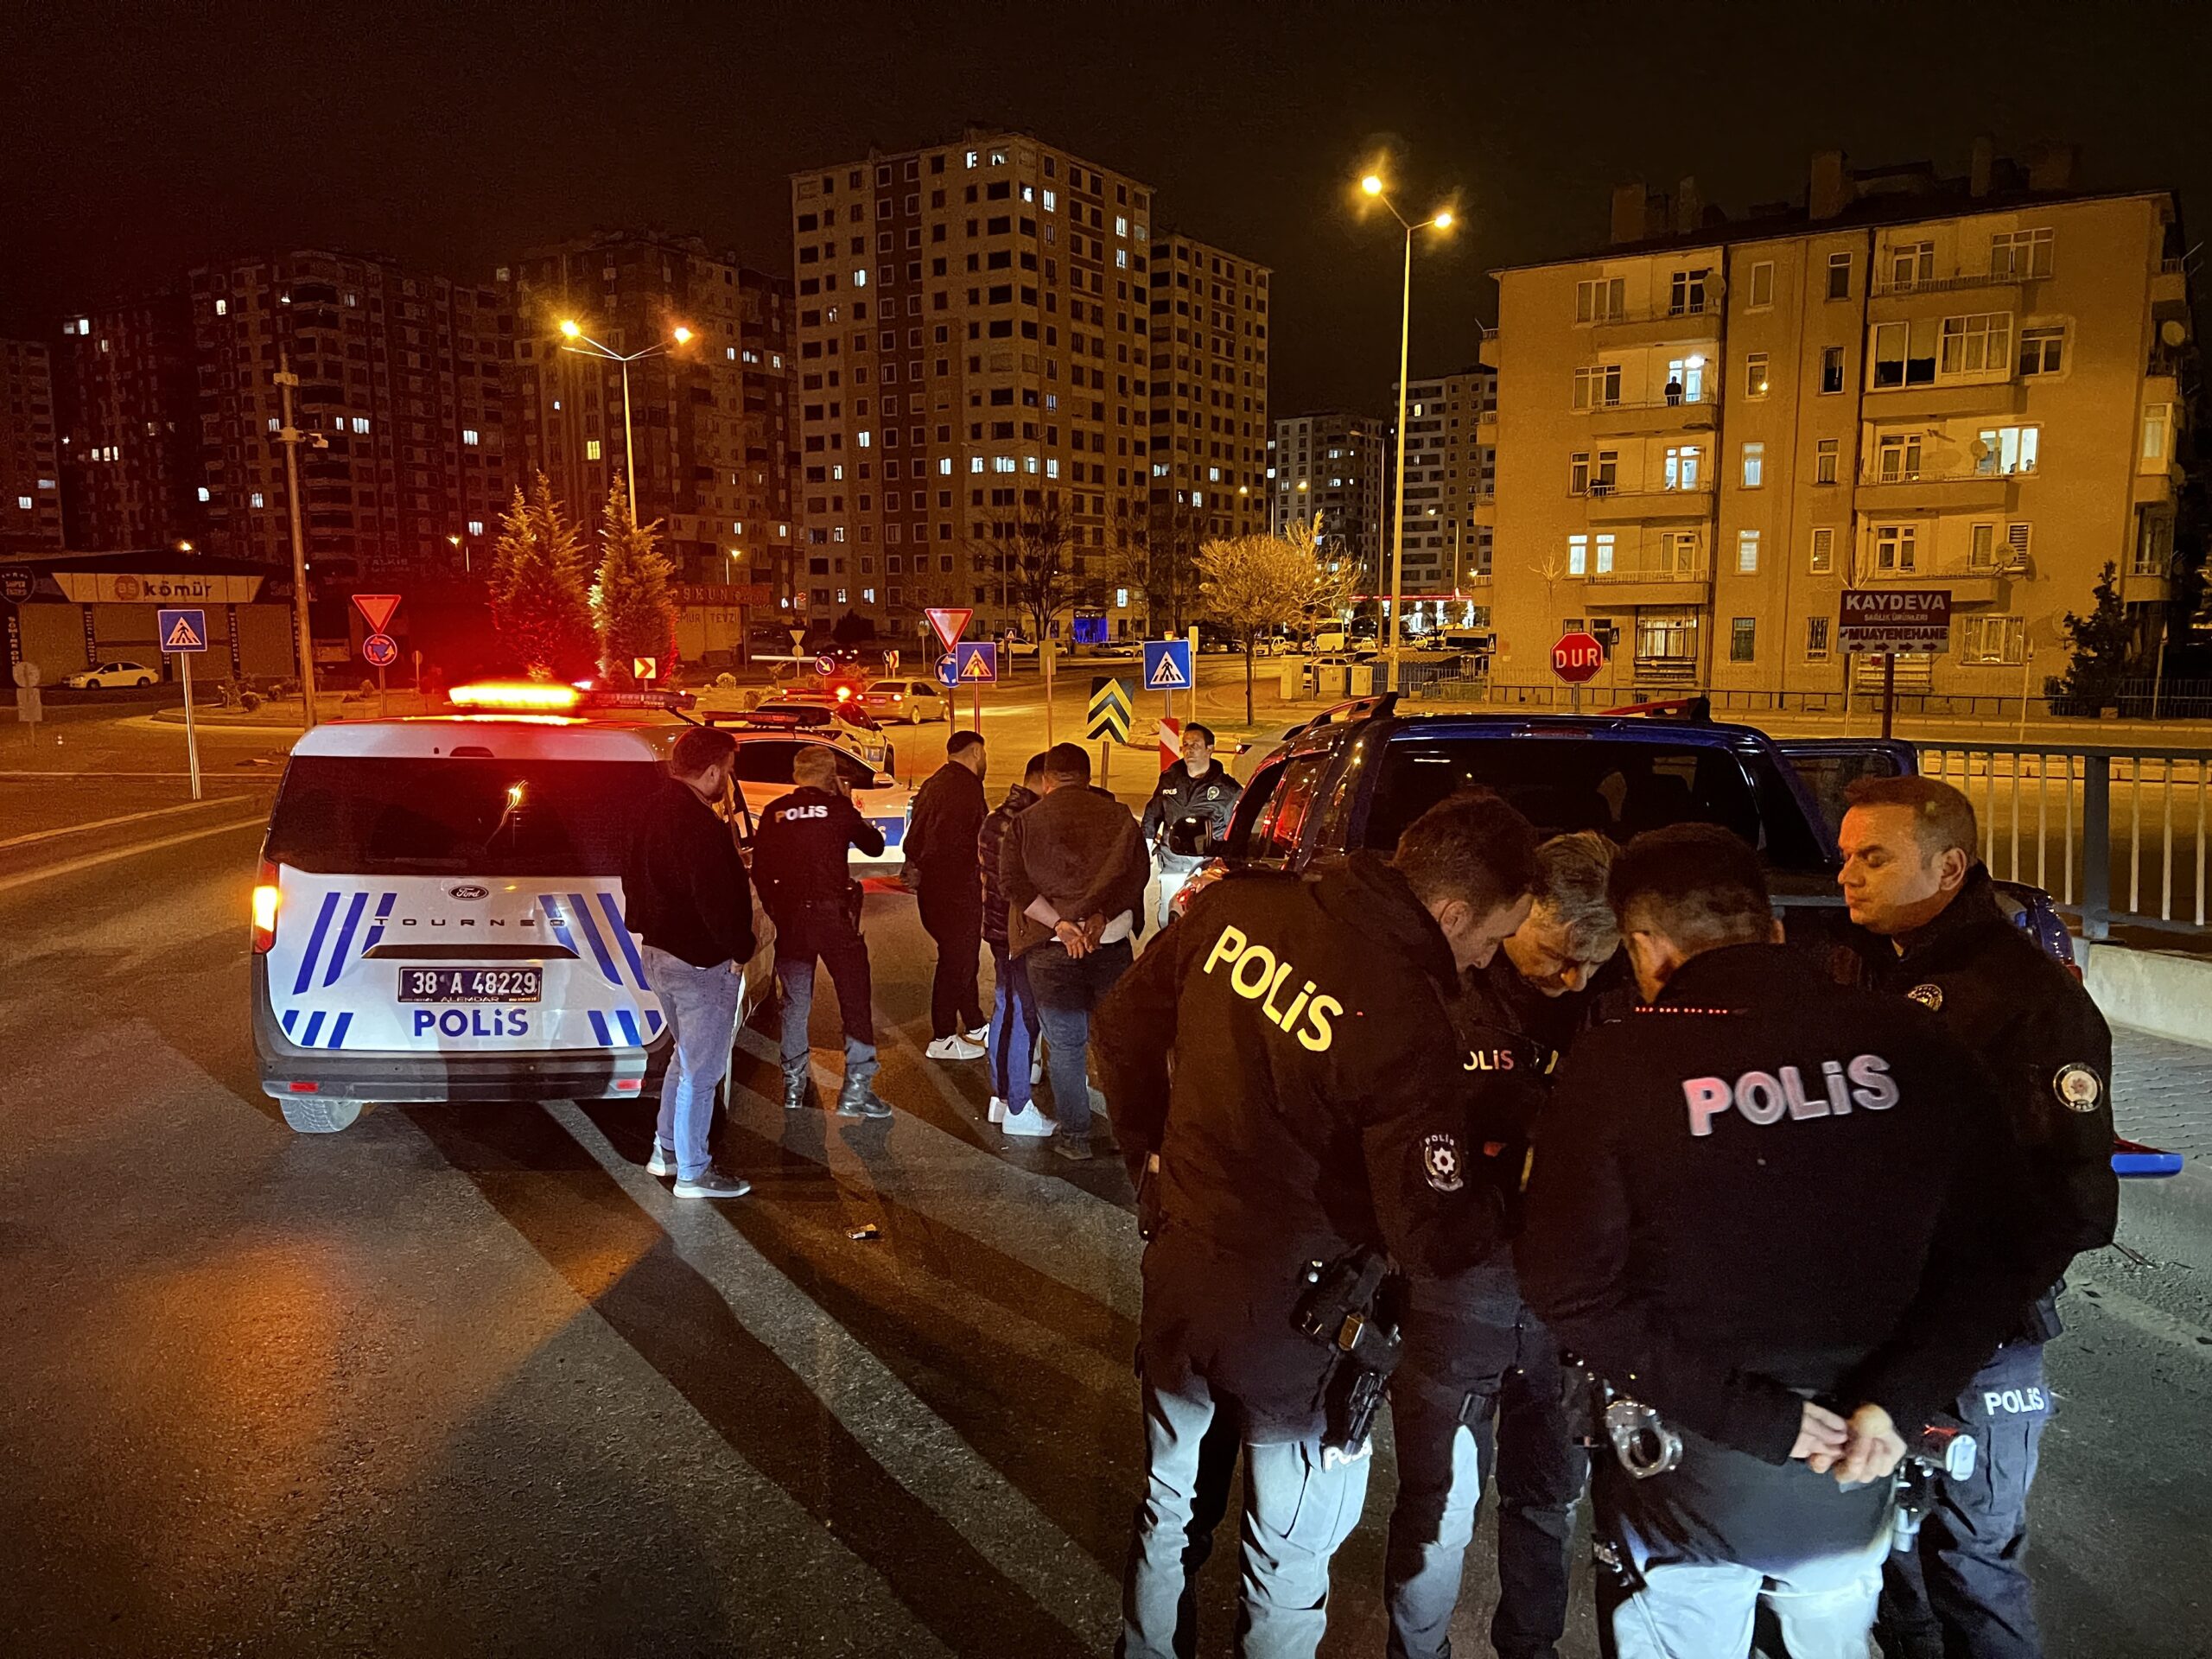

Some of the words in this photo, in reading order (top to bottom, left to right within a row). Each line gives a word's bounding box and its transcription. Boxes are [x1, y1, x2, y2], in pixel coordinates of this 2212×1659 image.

[143, 581, 212, 597] kömür
[1846, 594, 1945, 610] KAYDEVA
[1847, 627, 1948, 640] MUAYENEHANE
[1555, 648, 1599, 669] DUR
[455, 887, 480, 899] Ford
[374, 918, 565, 926] TOURNEO
[412, 971, 437, 995] 38
[449, 972, 463, 994] A
[472, 971, 537, 995] 48229
